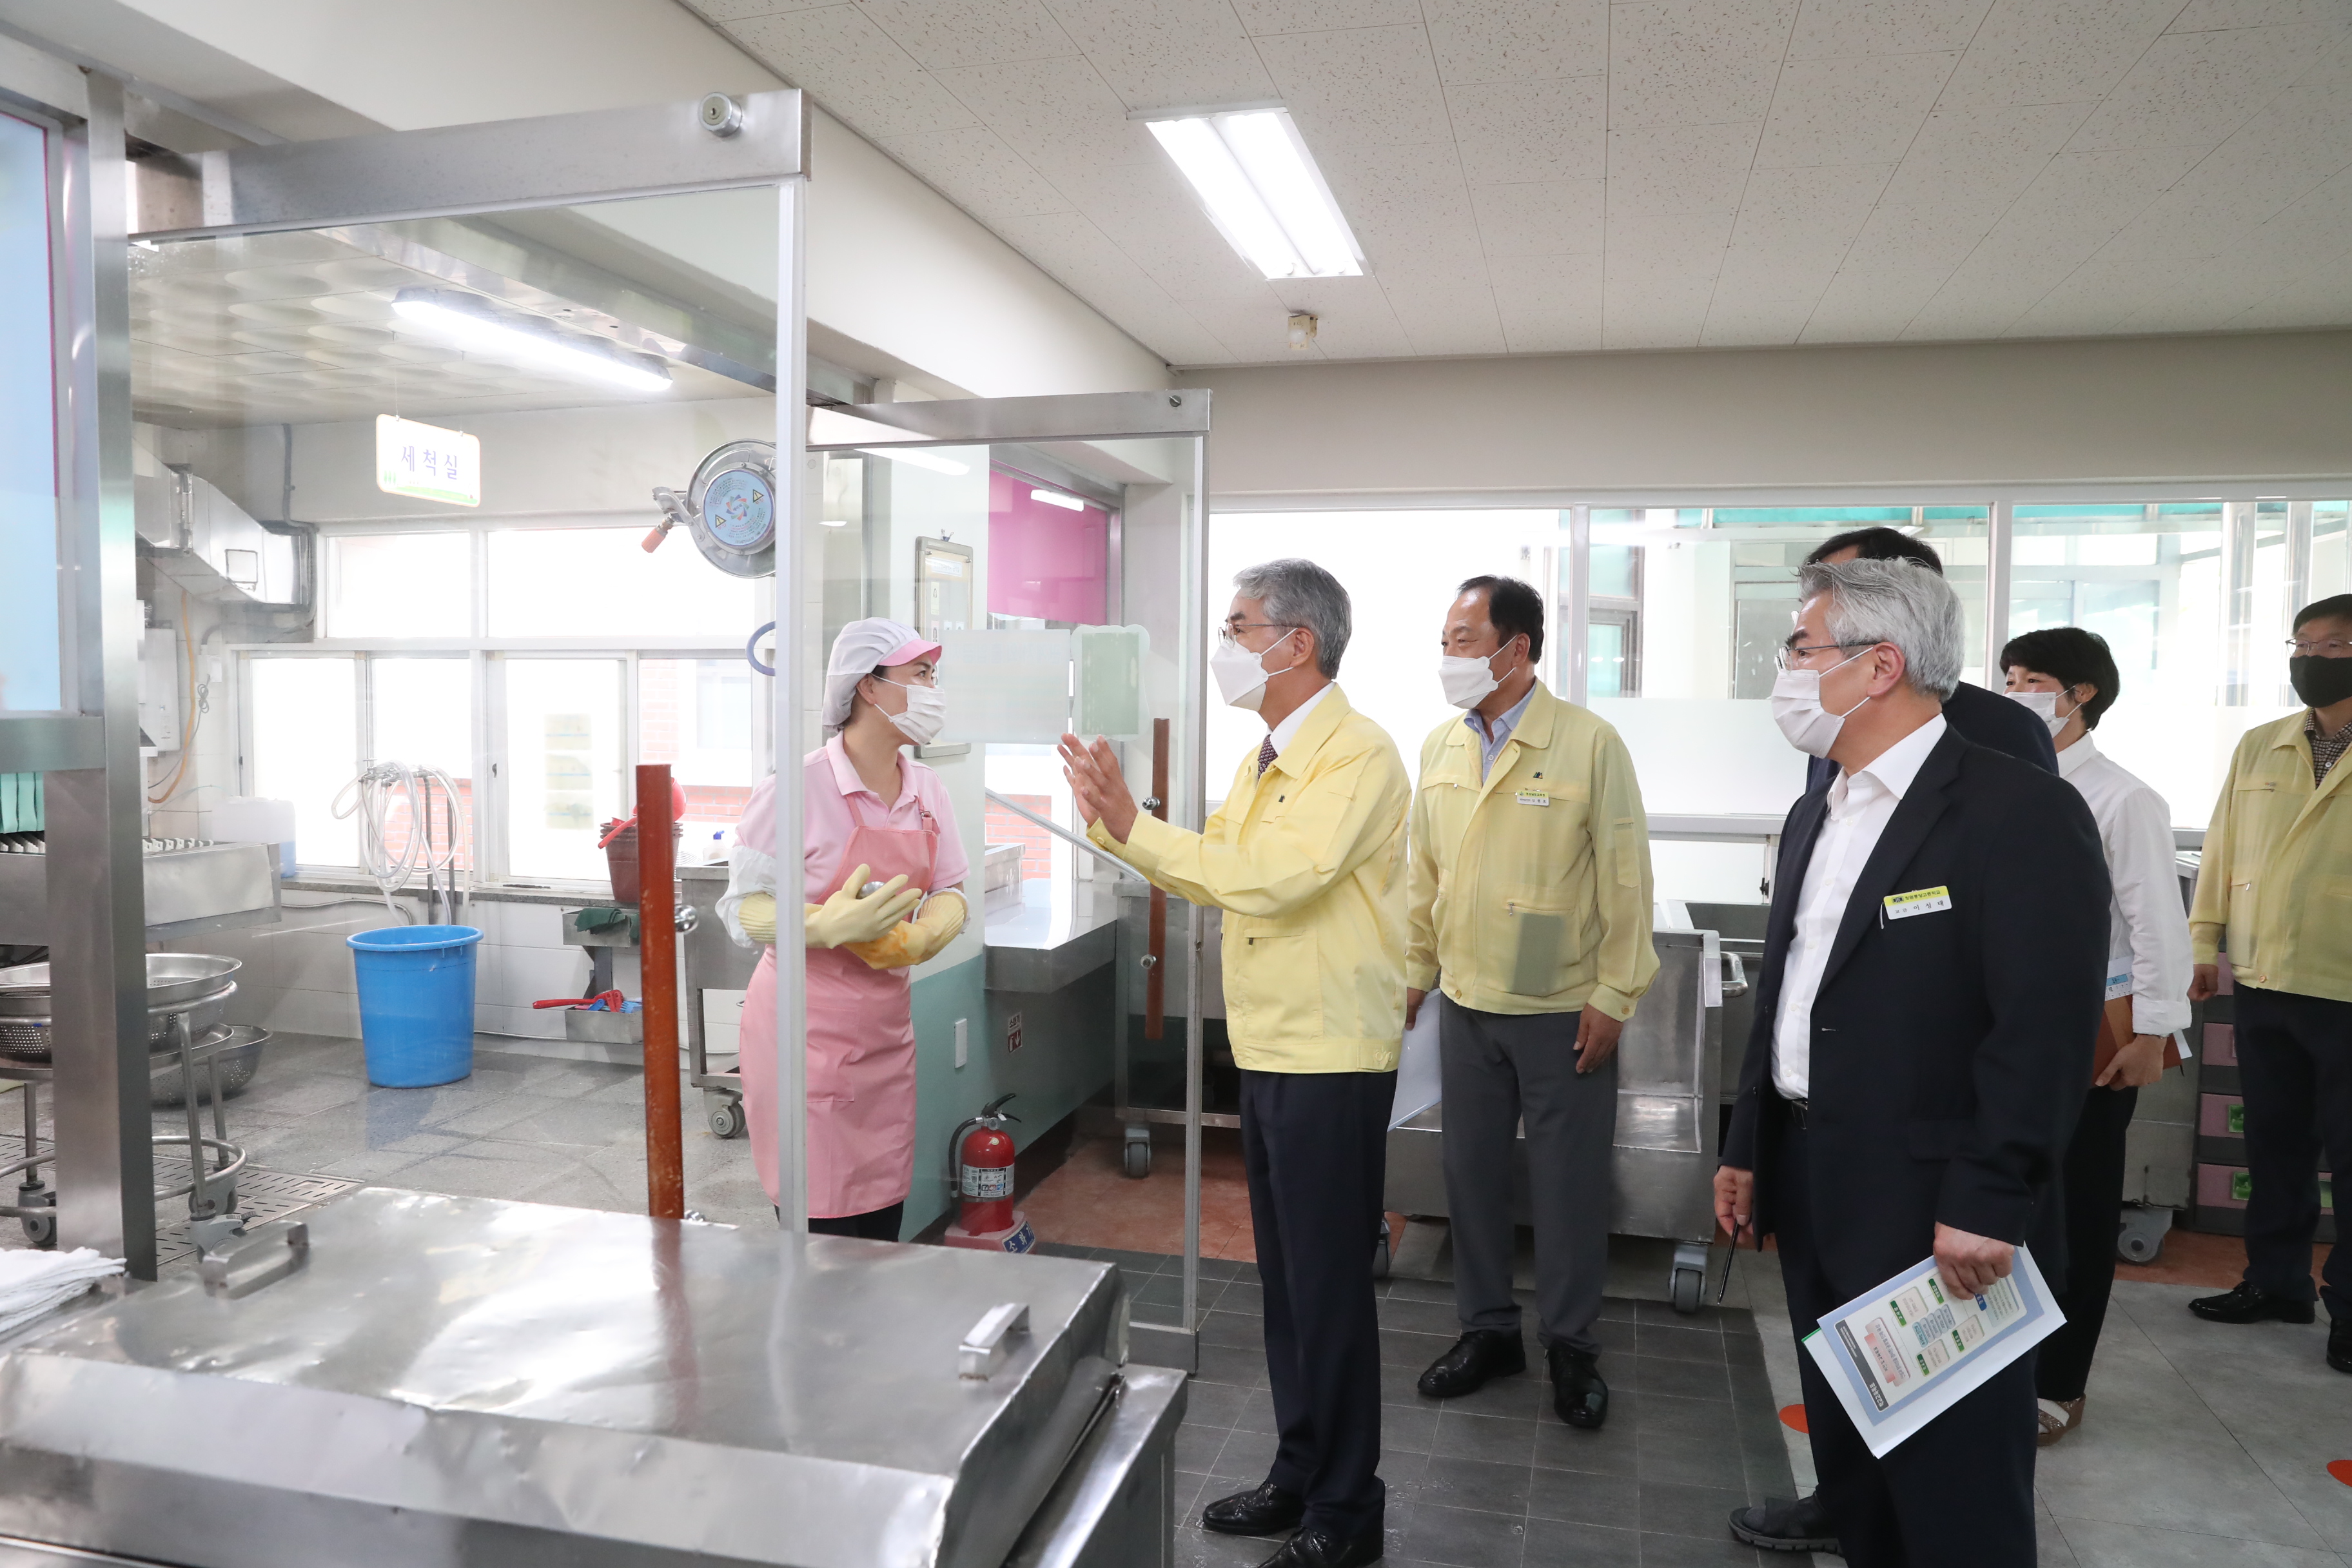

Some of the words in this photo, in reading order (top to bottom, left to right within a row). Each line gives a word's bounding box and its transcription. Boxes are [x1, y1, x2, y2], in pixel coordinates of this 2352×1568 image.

[401, 446, 457, 480] 세척실
[1905, 890, 1941, 900] 창원중앙고등학교
[1009, 1014, 1020, 1028] 소화기
[1874, 1346, 1882, 1360] 교육목표
[1869, 1382, 1885, 1406] 학교교육목표
